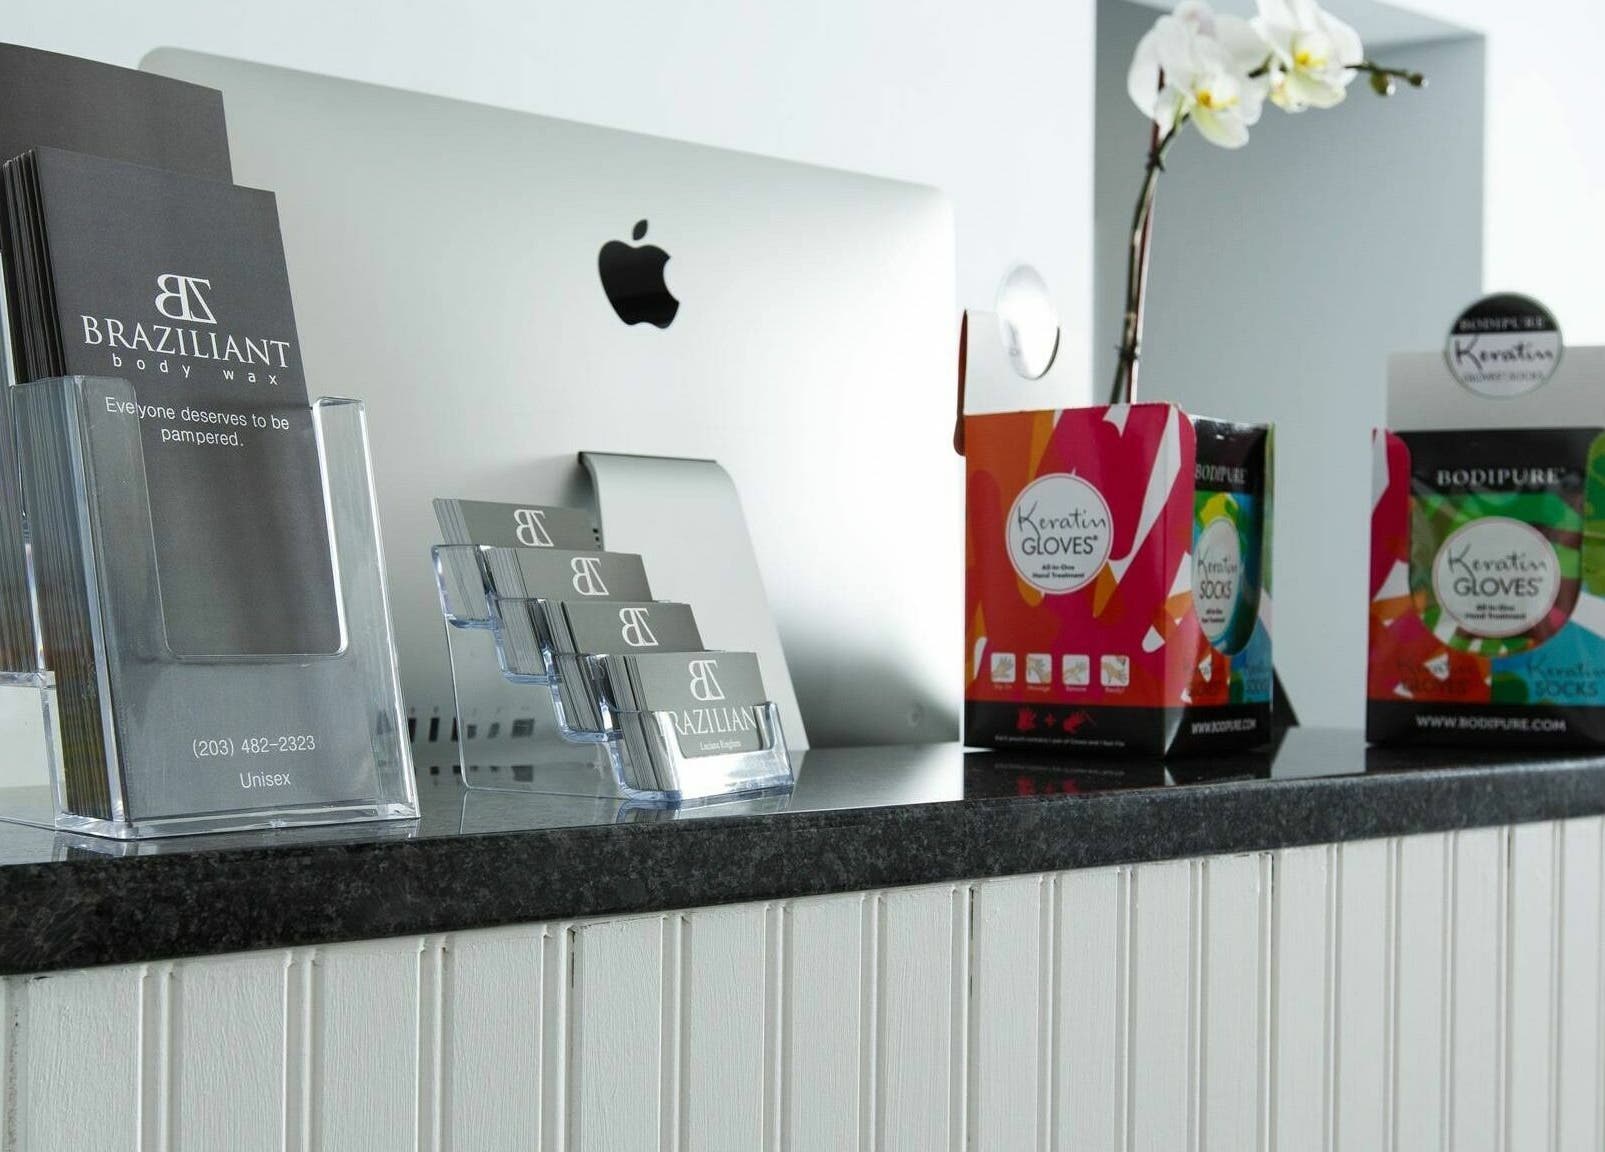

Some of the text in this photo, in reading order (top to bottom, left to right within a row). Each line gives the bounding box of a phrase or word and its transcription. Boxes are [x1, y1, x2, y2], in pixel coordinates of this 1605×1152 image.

[80, 314, 290, 368] BRAZILIANT
[1454, 335, 1553, 371] Keratin
[113, 353, 278, 385] body wax
[181, 406, 247, 427] deserves
[251, 414, 266, 428] to
[271, 414, 290, 430] be
[161, 428, 244, 447] pampered.
[1018, 500, 1106, 536] Keratin
[1447, 544, 1547, 577] Keratin
[1200, 580, 1232, 600] SOCKS
[1415, 715, 1567, 732] WWW.BODIPURE.COM
[192, 735, 316, 758] (203) 482-2323
[240, 771, 291, 788] Unisex
